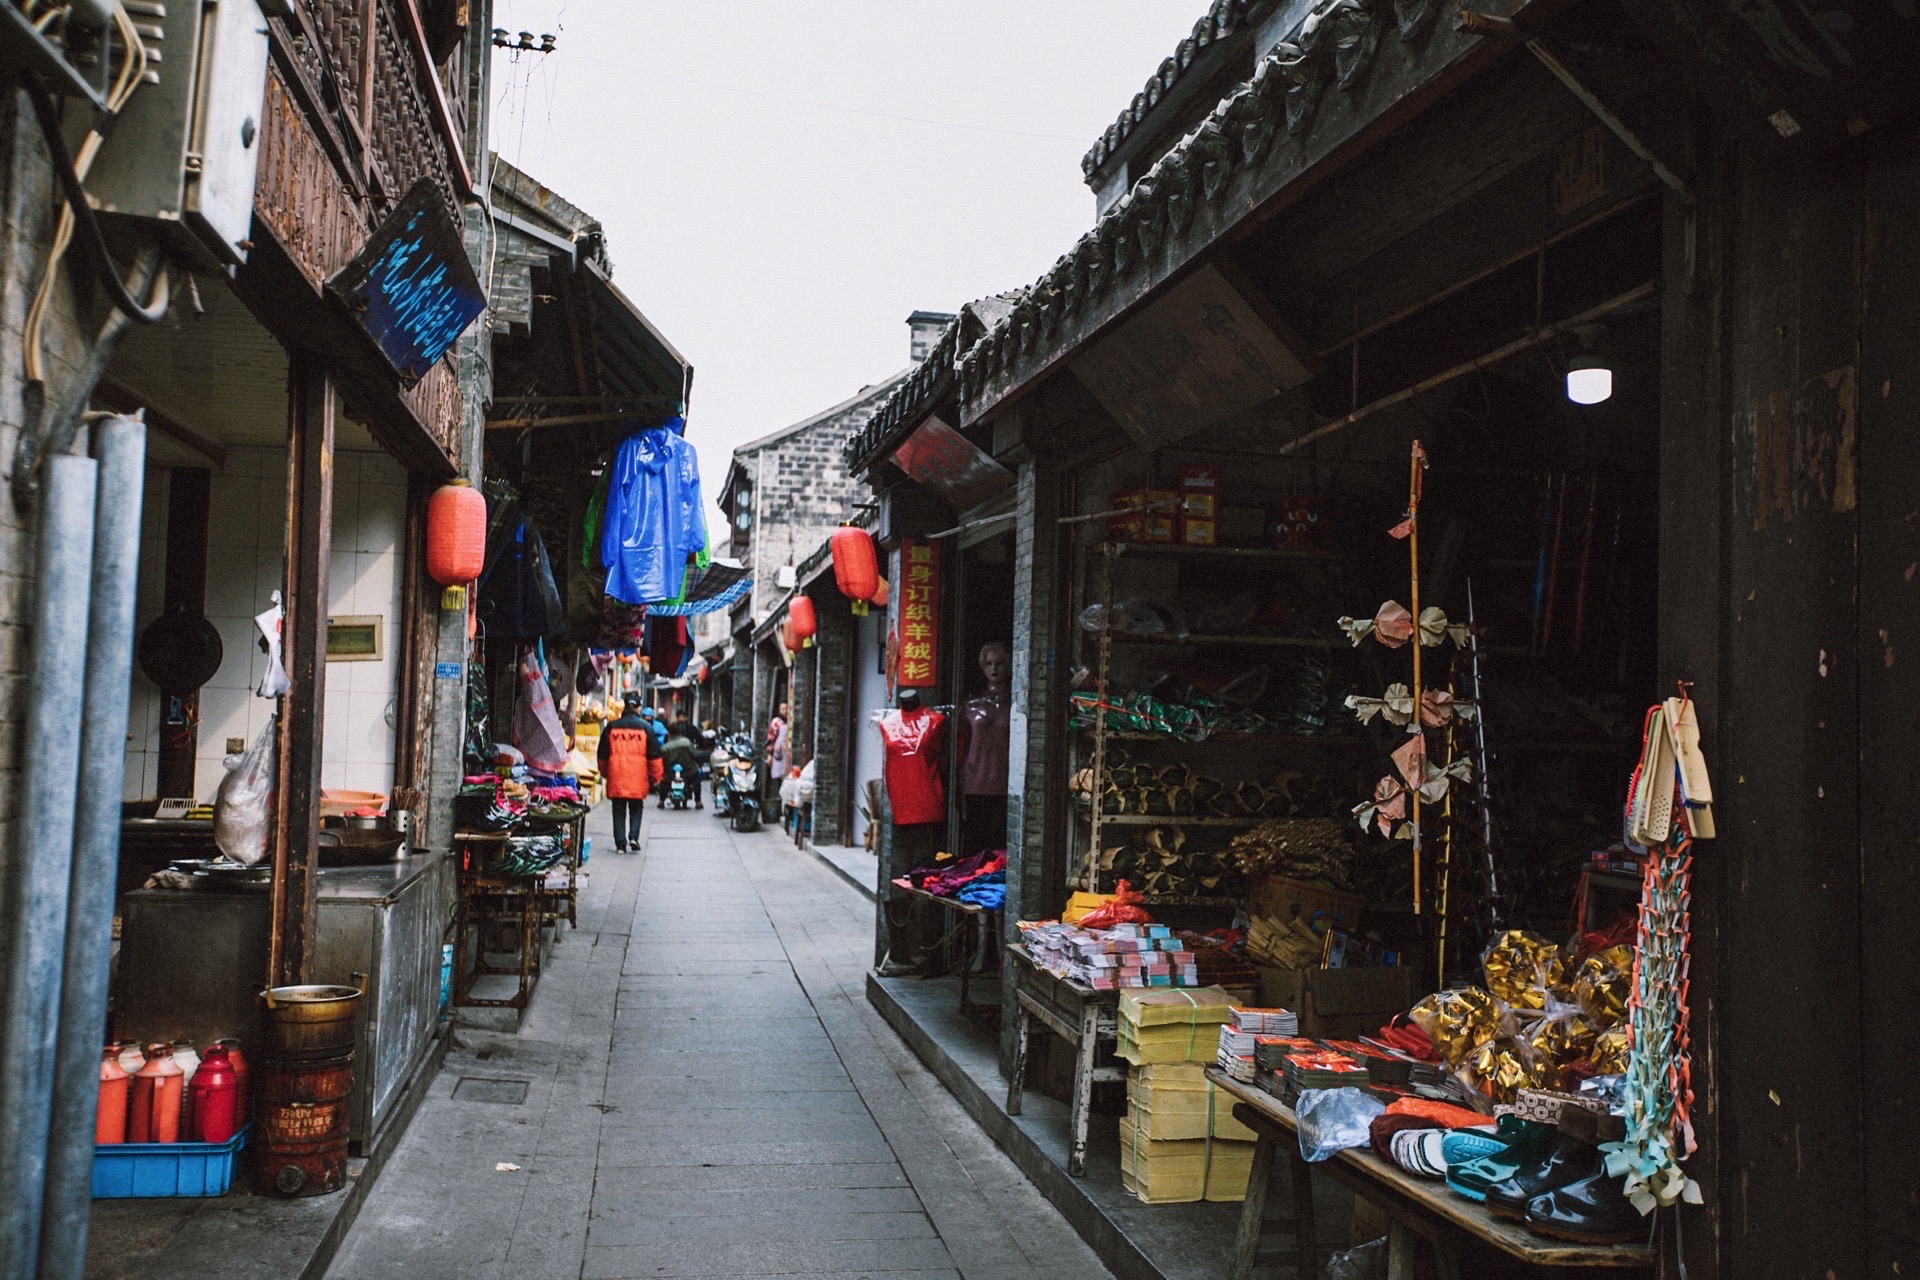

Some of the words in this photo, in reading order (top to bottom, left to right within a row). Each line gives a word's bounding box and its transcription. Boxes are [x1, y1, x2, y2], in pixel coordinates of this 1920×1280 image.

[904, 546, 933, 679] 量身订织羊绒衫
